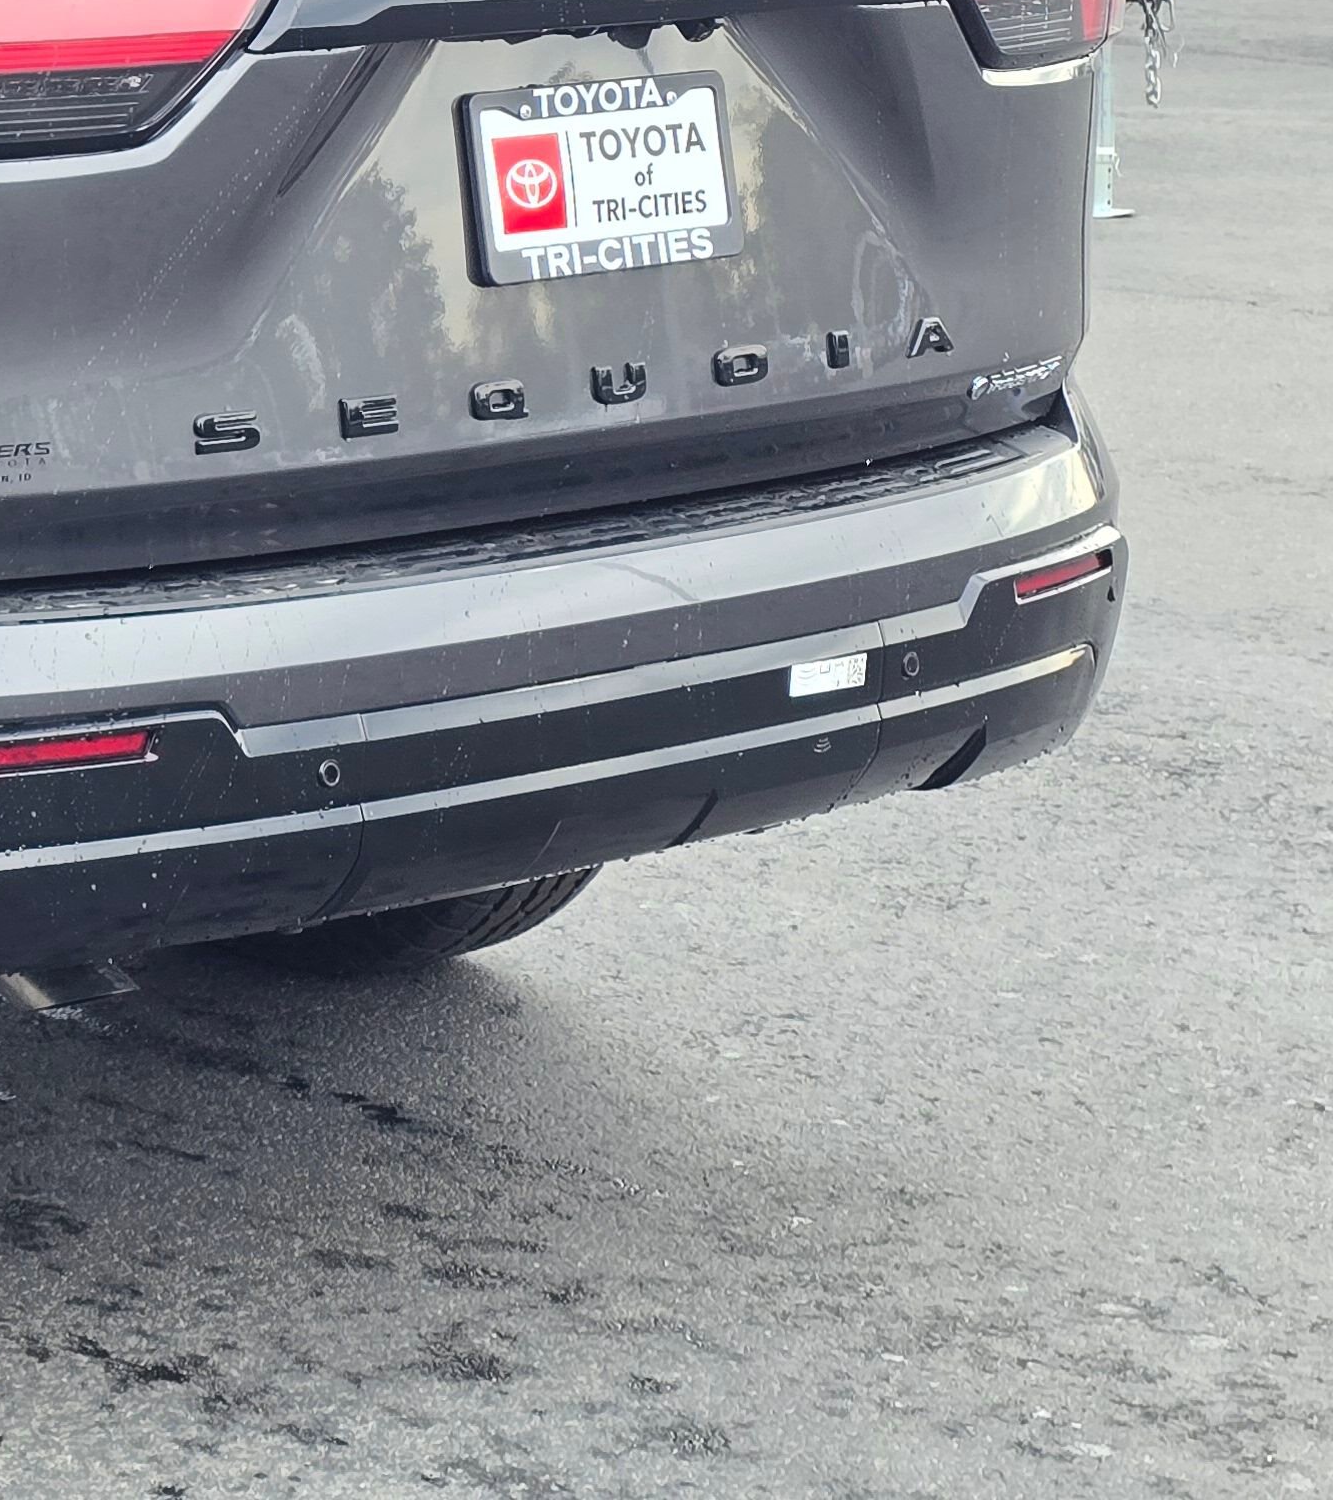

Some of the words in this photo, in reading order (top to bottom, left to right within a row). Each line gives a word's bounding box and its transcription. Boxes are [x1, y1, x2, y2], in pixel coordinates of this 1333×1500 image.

[533, 78, 666, 118] TOYOTA
[579, 122, 706, 163] TOYOTA
[634, 163, 654, 187] of
[592, 189, 707, 224] TRI-CITIES
[521, 227, 714, 280] TRI-CITIES
[192, 316, 954, 456] SEQUOIA
[18, 472, 32, 482] ID
